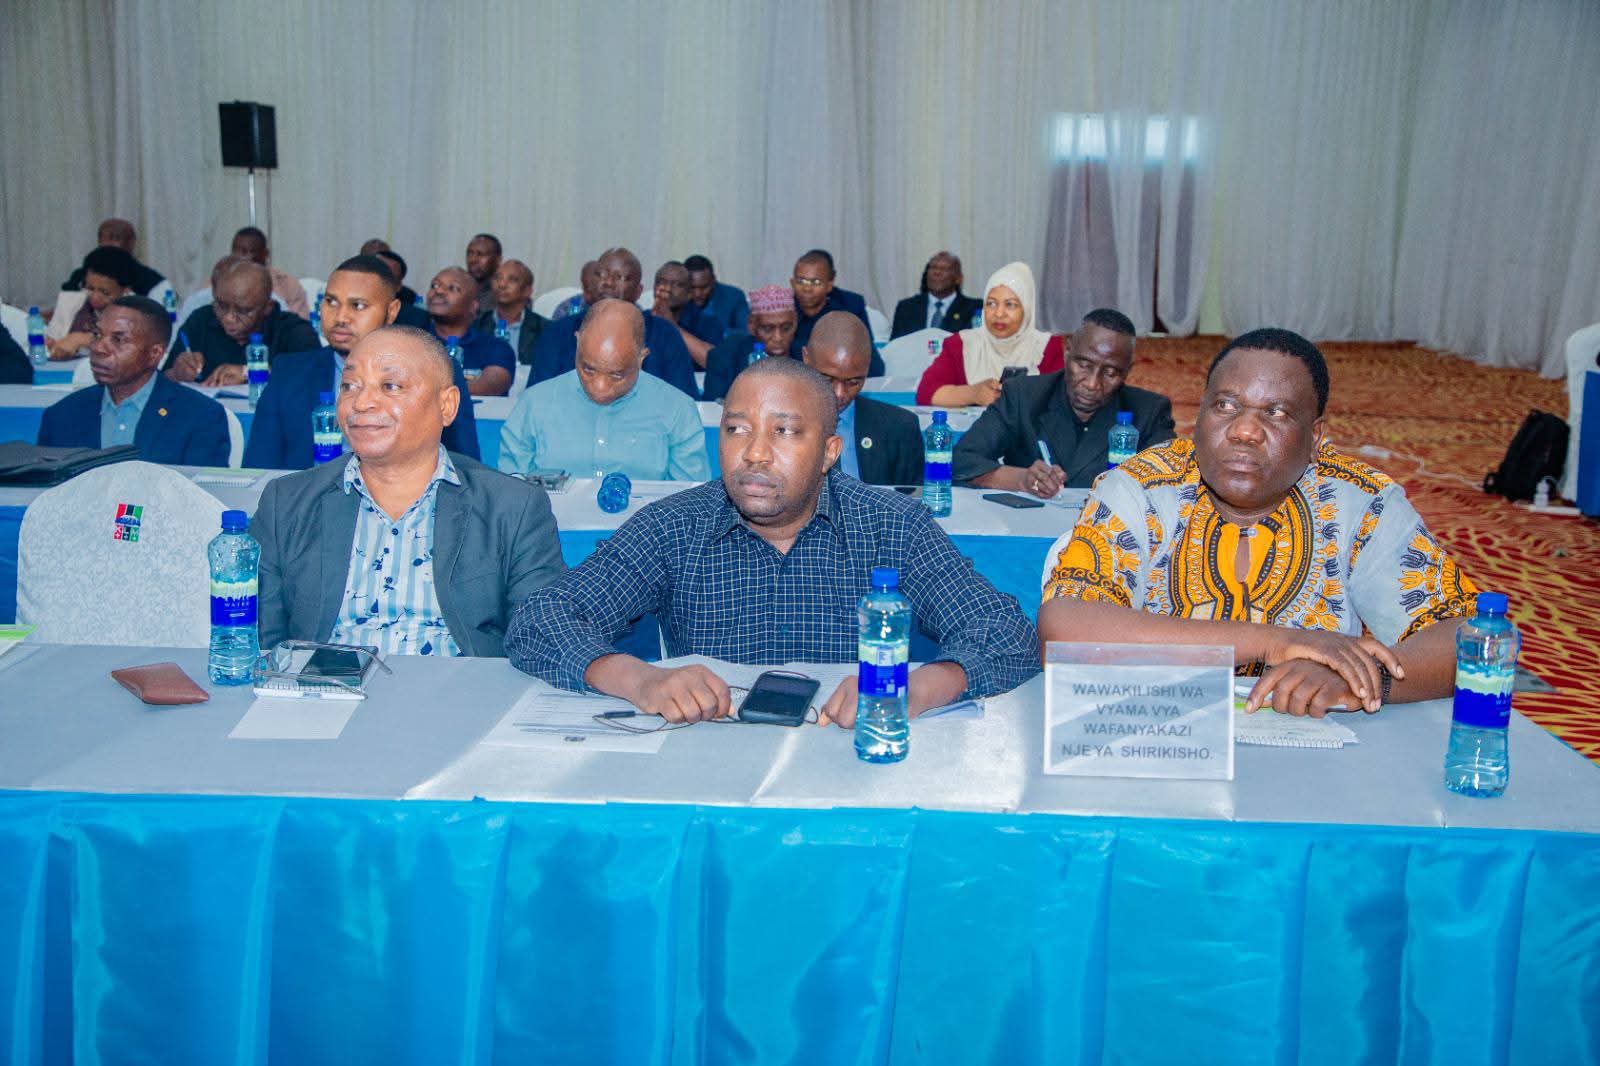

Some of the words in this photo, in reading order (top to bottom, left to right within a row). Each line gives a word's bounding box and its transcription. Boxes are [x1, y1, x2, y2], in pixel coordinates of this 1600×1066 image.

[1072, 683, 1176, 698] WAWAKILISHI
[1179, 685, 1204, 698] WA
[1096, 703, 1149, 717] VYAMA
[1151, 704, 1181, 717] VYA
[1083, 723, 1192, 737] WAFANYAKAZI
[1121, 745, 1215, 760] SHIRIKISHO.
